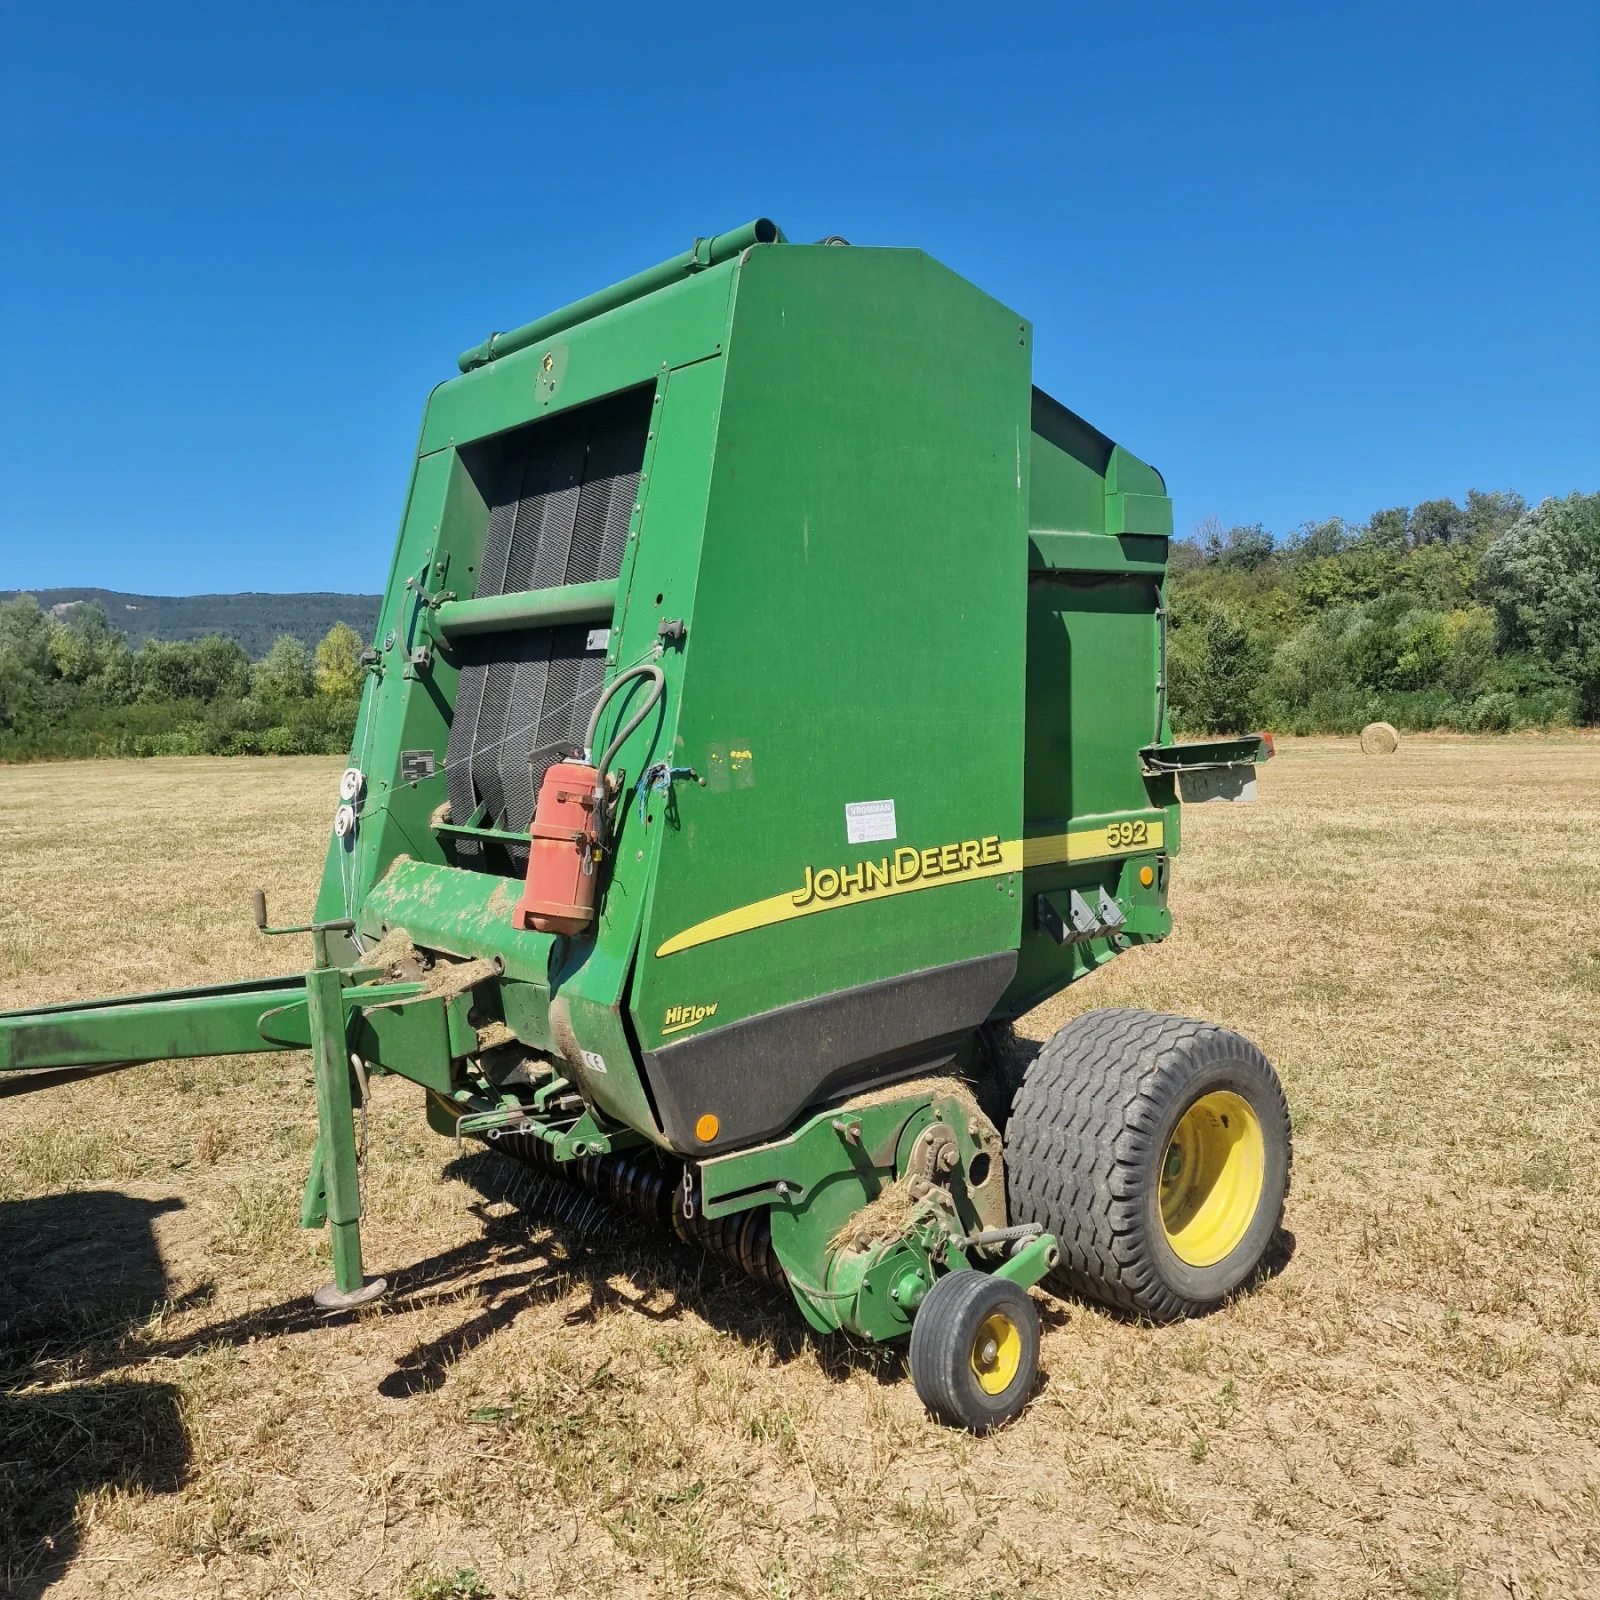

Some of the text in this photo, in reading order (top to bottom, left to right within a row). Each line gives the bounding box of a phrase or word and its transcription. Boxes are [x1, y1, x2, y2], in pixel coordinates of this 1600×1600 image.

[850, 803, 891, 815] VROMMAN
[1107, 820, 1147, 848] 592
[792, 835, 1001, 905] JOHN DEERE
